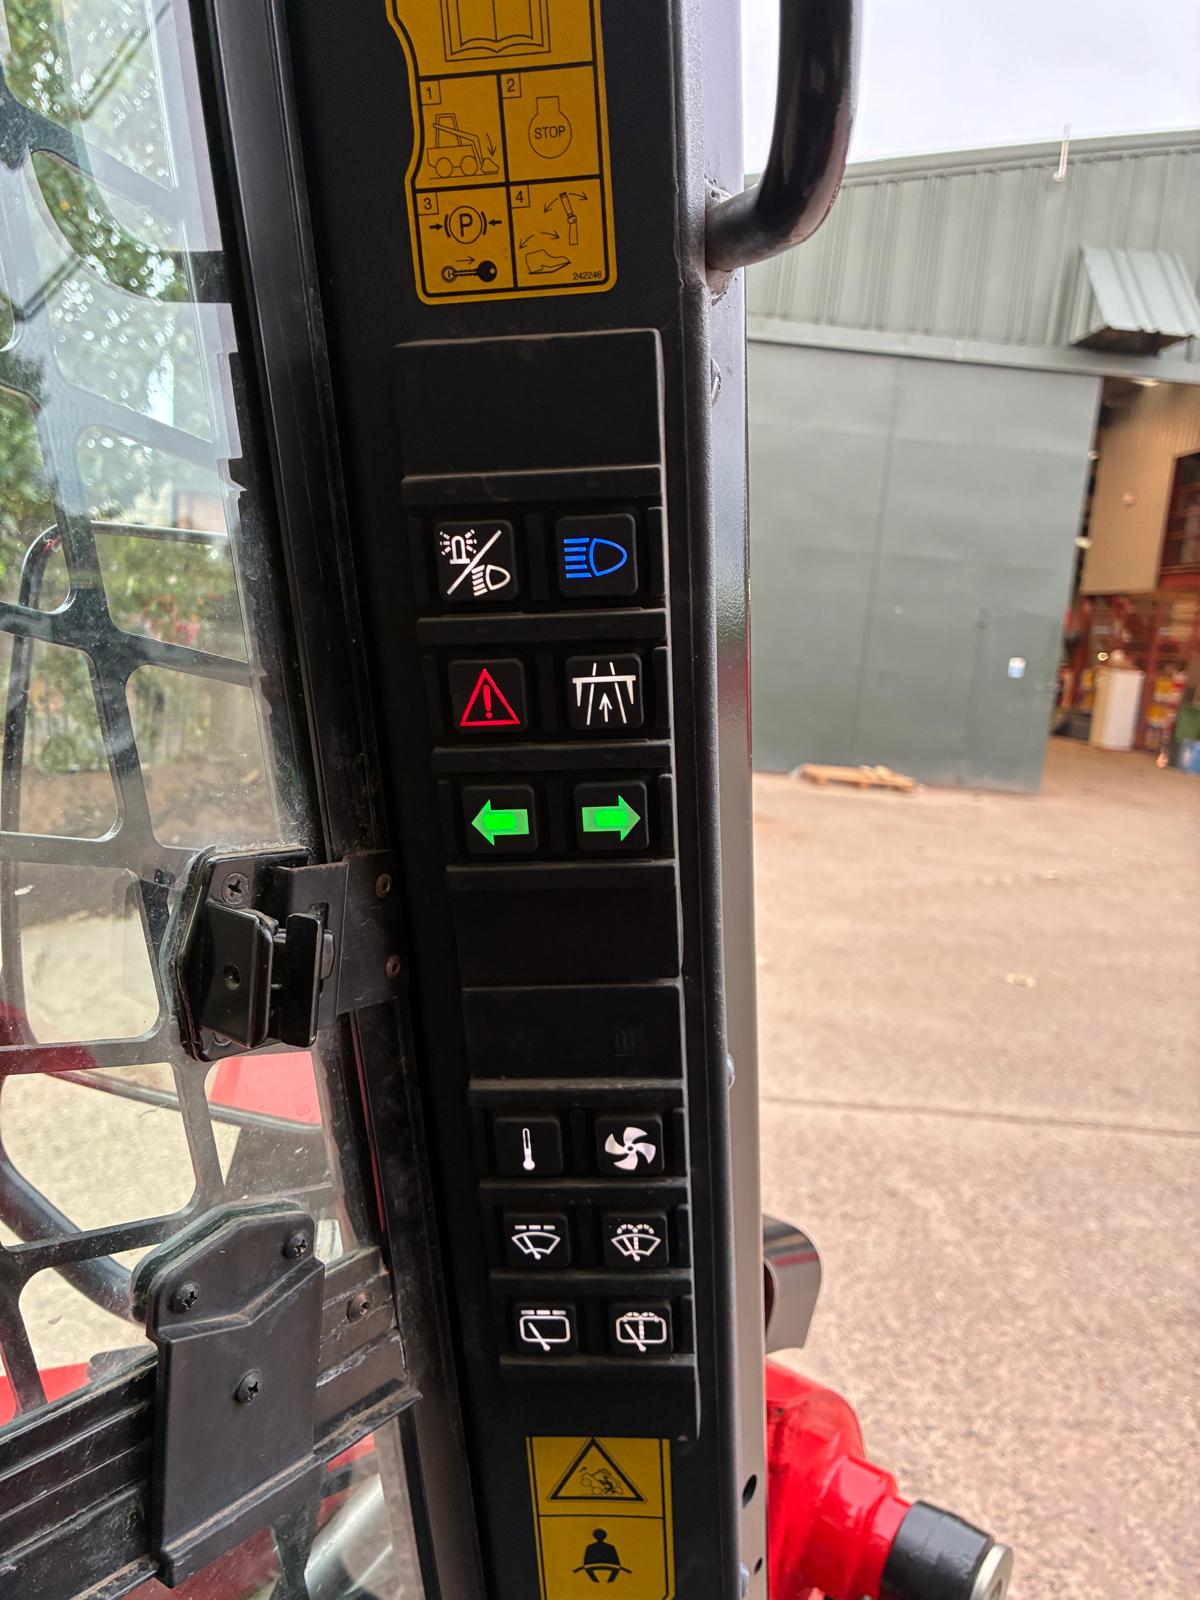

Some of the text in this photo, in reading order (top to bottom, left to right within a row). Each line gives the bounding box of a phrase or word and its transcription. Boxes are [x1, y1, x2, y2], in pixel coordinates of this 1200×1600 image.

[507, 77, 515, 92] 2
[426, 86, 433, 100] 1
[534, 125, 566, 140] STOP
[423, 196, 432, 210] 3
[515, 189, 524, 203] 4
[458, 213, 473, 237] P
